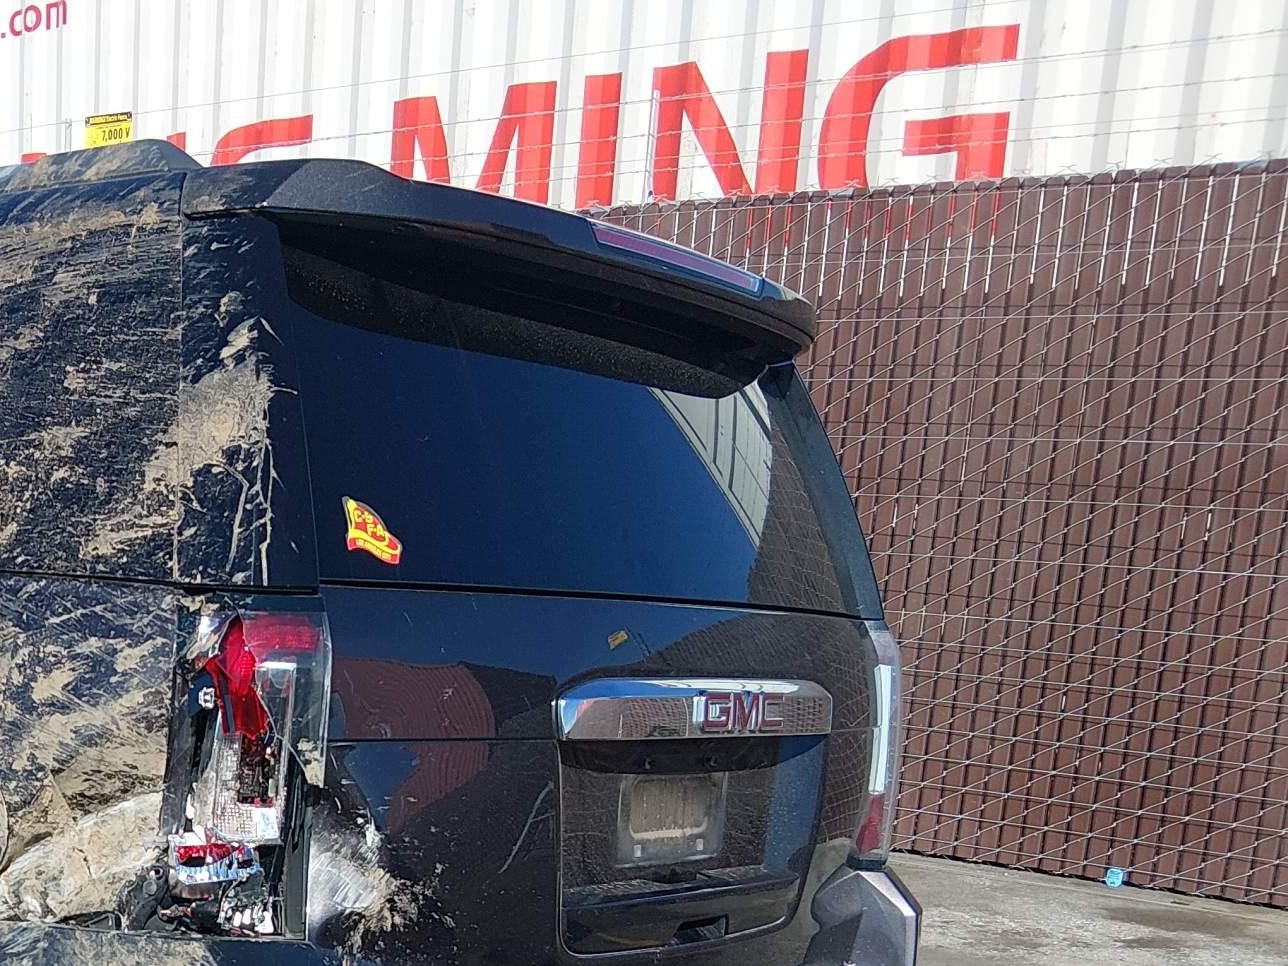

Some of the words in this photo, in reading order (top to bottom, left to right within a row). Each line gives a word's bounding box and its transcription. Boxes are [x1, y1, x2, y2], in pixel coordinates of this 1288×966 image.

[102, 127, 123, 142] 7,000
[125, 126, 131, 138] V
[390, 23, 1020, 208] MING
[693, 692, 785, 734] GMC
